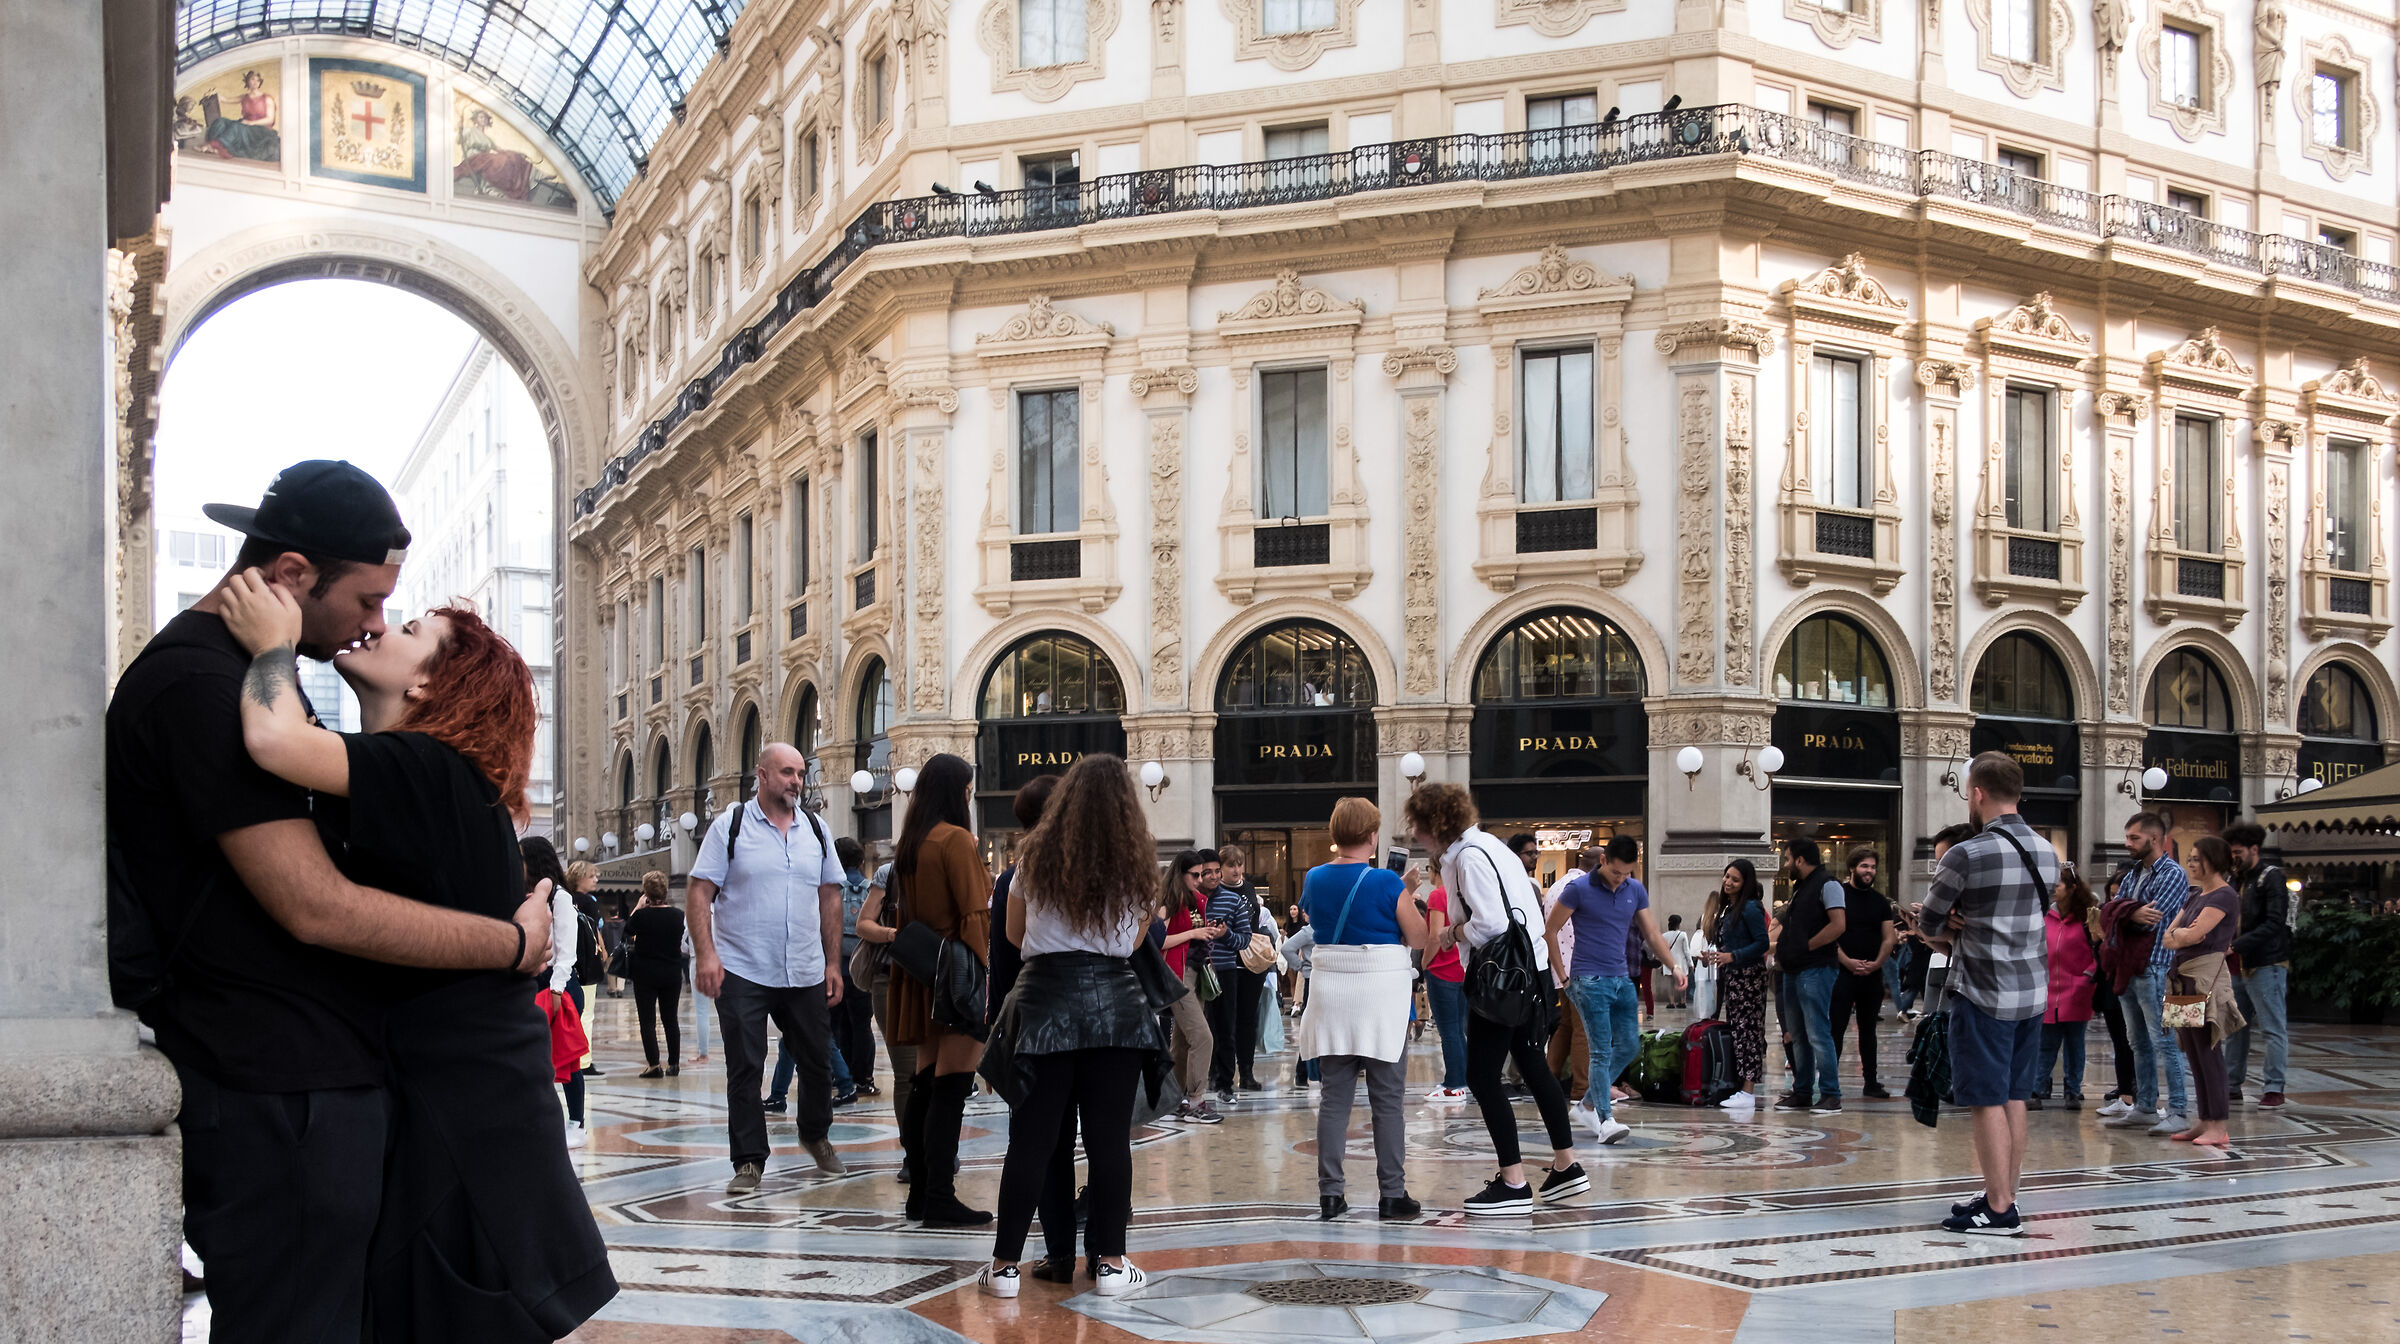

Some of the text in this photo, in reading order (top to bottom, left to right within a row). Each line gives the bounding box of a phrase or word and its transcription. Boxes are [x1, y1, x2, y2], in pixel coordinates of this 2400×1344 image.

[1519, 736, 1599, 751] PRADA
[1804, 733, 1864, 750] PRADA
[1259, 744, 1333, 758] PRADA
[2165, 758, 2227, 779] Feltrinelli
[1971, 1212, 1991, 1227] N
